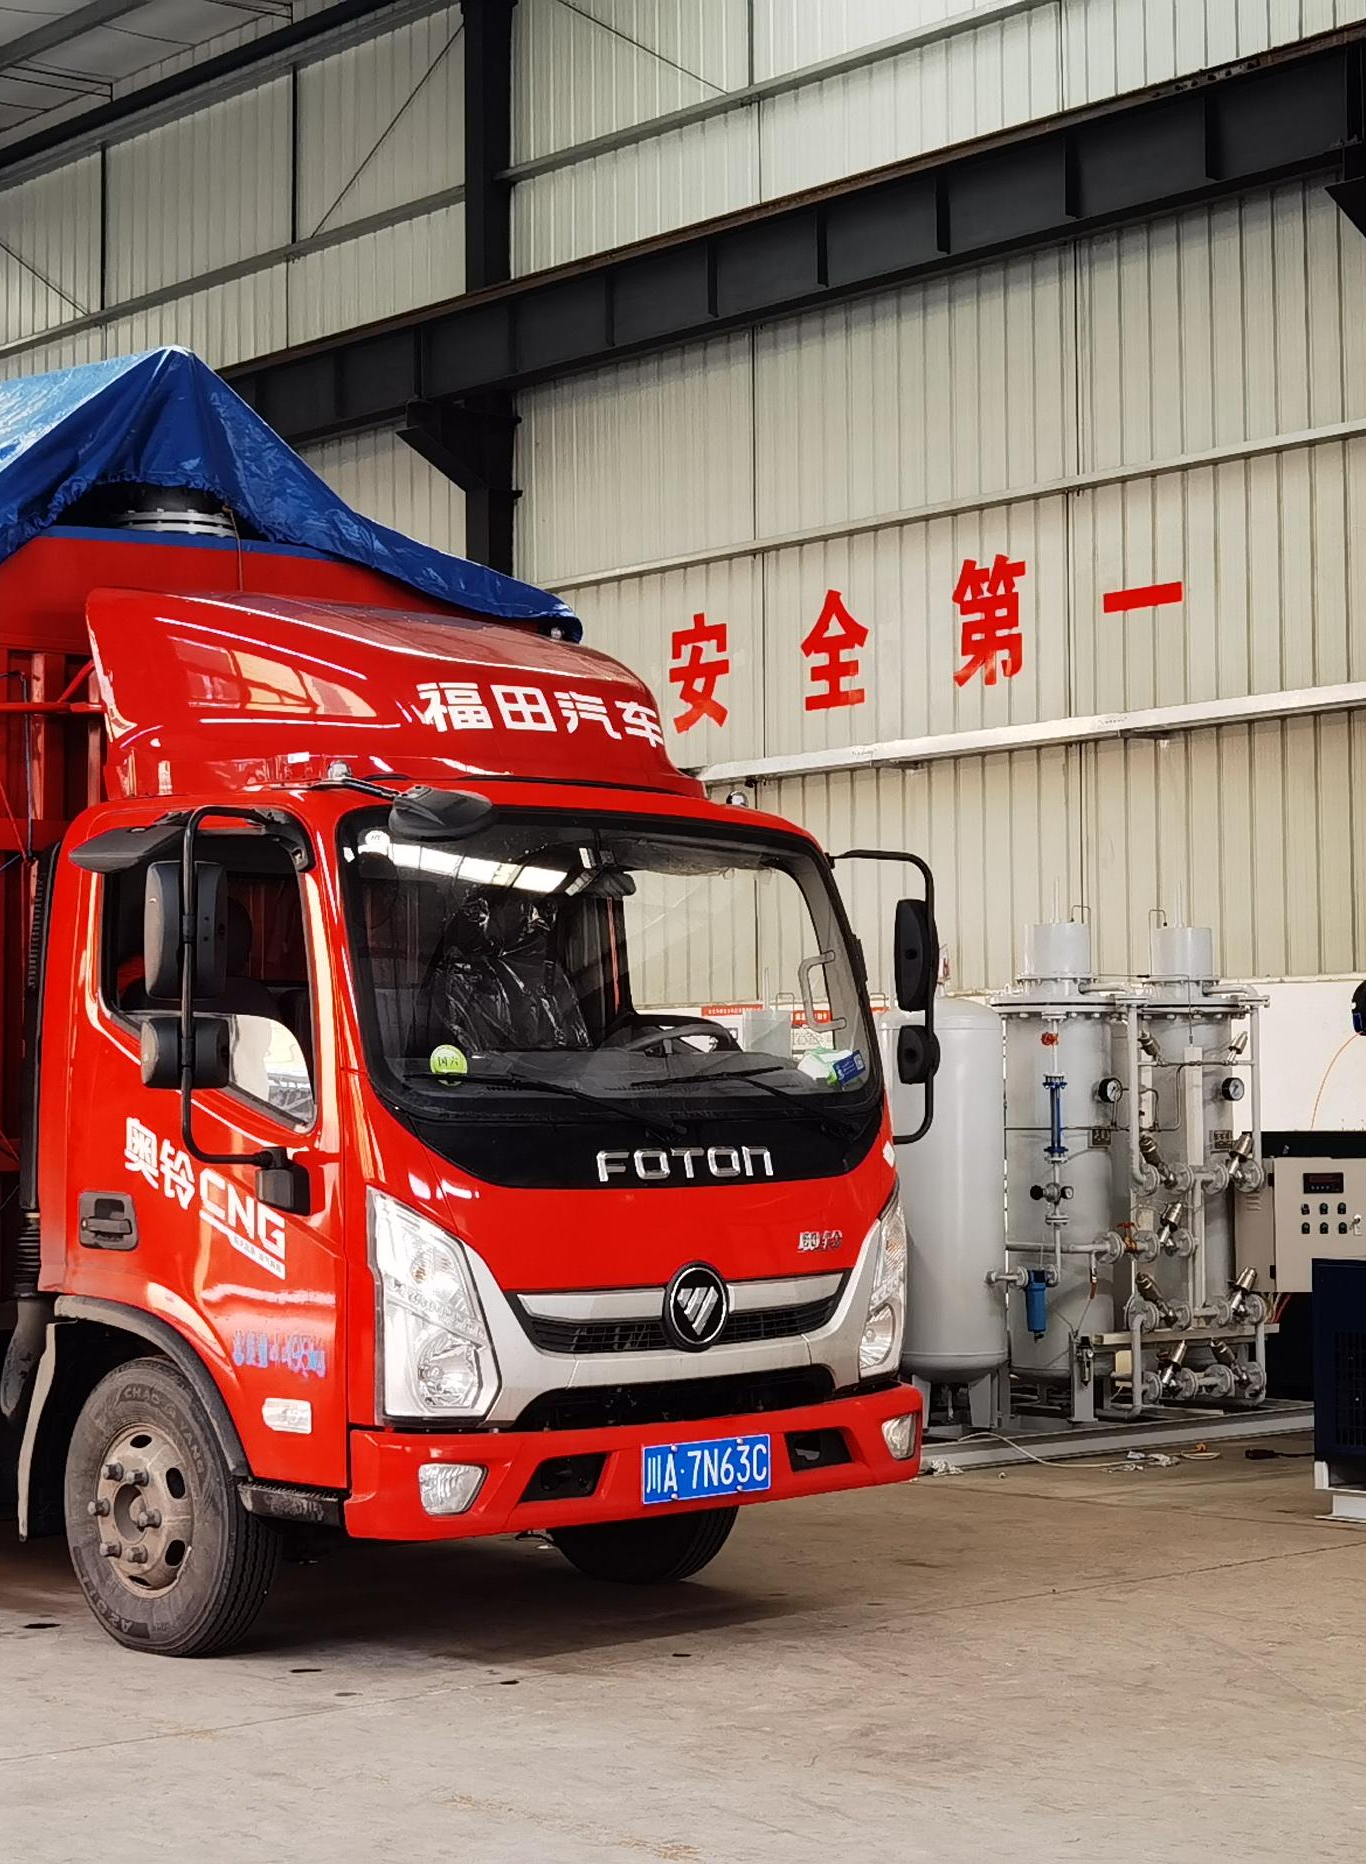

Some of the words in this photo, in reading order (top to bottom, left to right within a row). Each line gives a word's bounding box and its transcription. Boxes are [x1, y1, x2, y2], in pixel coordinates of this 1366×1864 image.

[669, 554, 1183, 734] 安全第一
[416, 682, 664, 747] 福田汽车
[124, 1117, 195, 1210] 奥铃
[199, 1168, 285, 1260] CNG
[596, 1146, 774, 1182] FOTON
